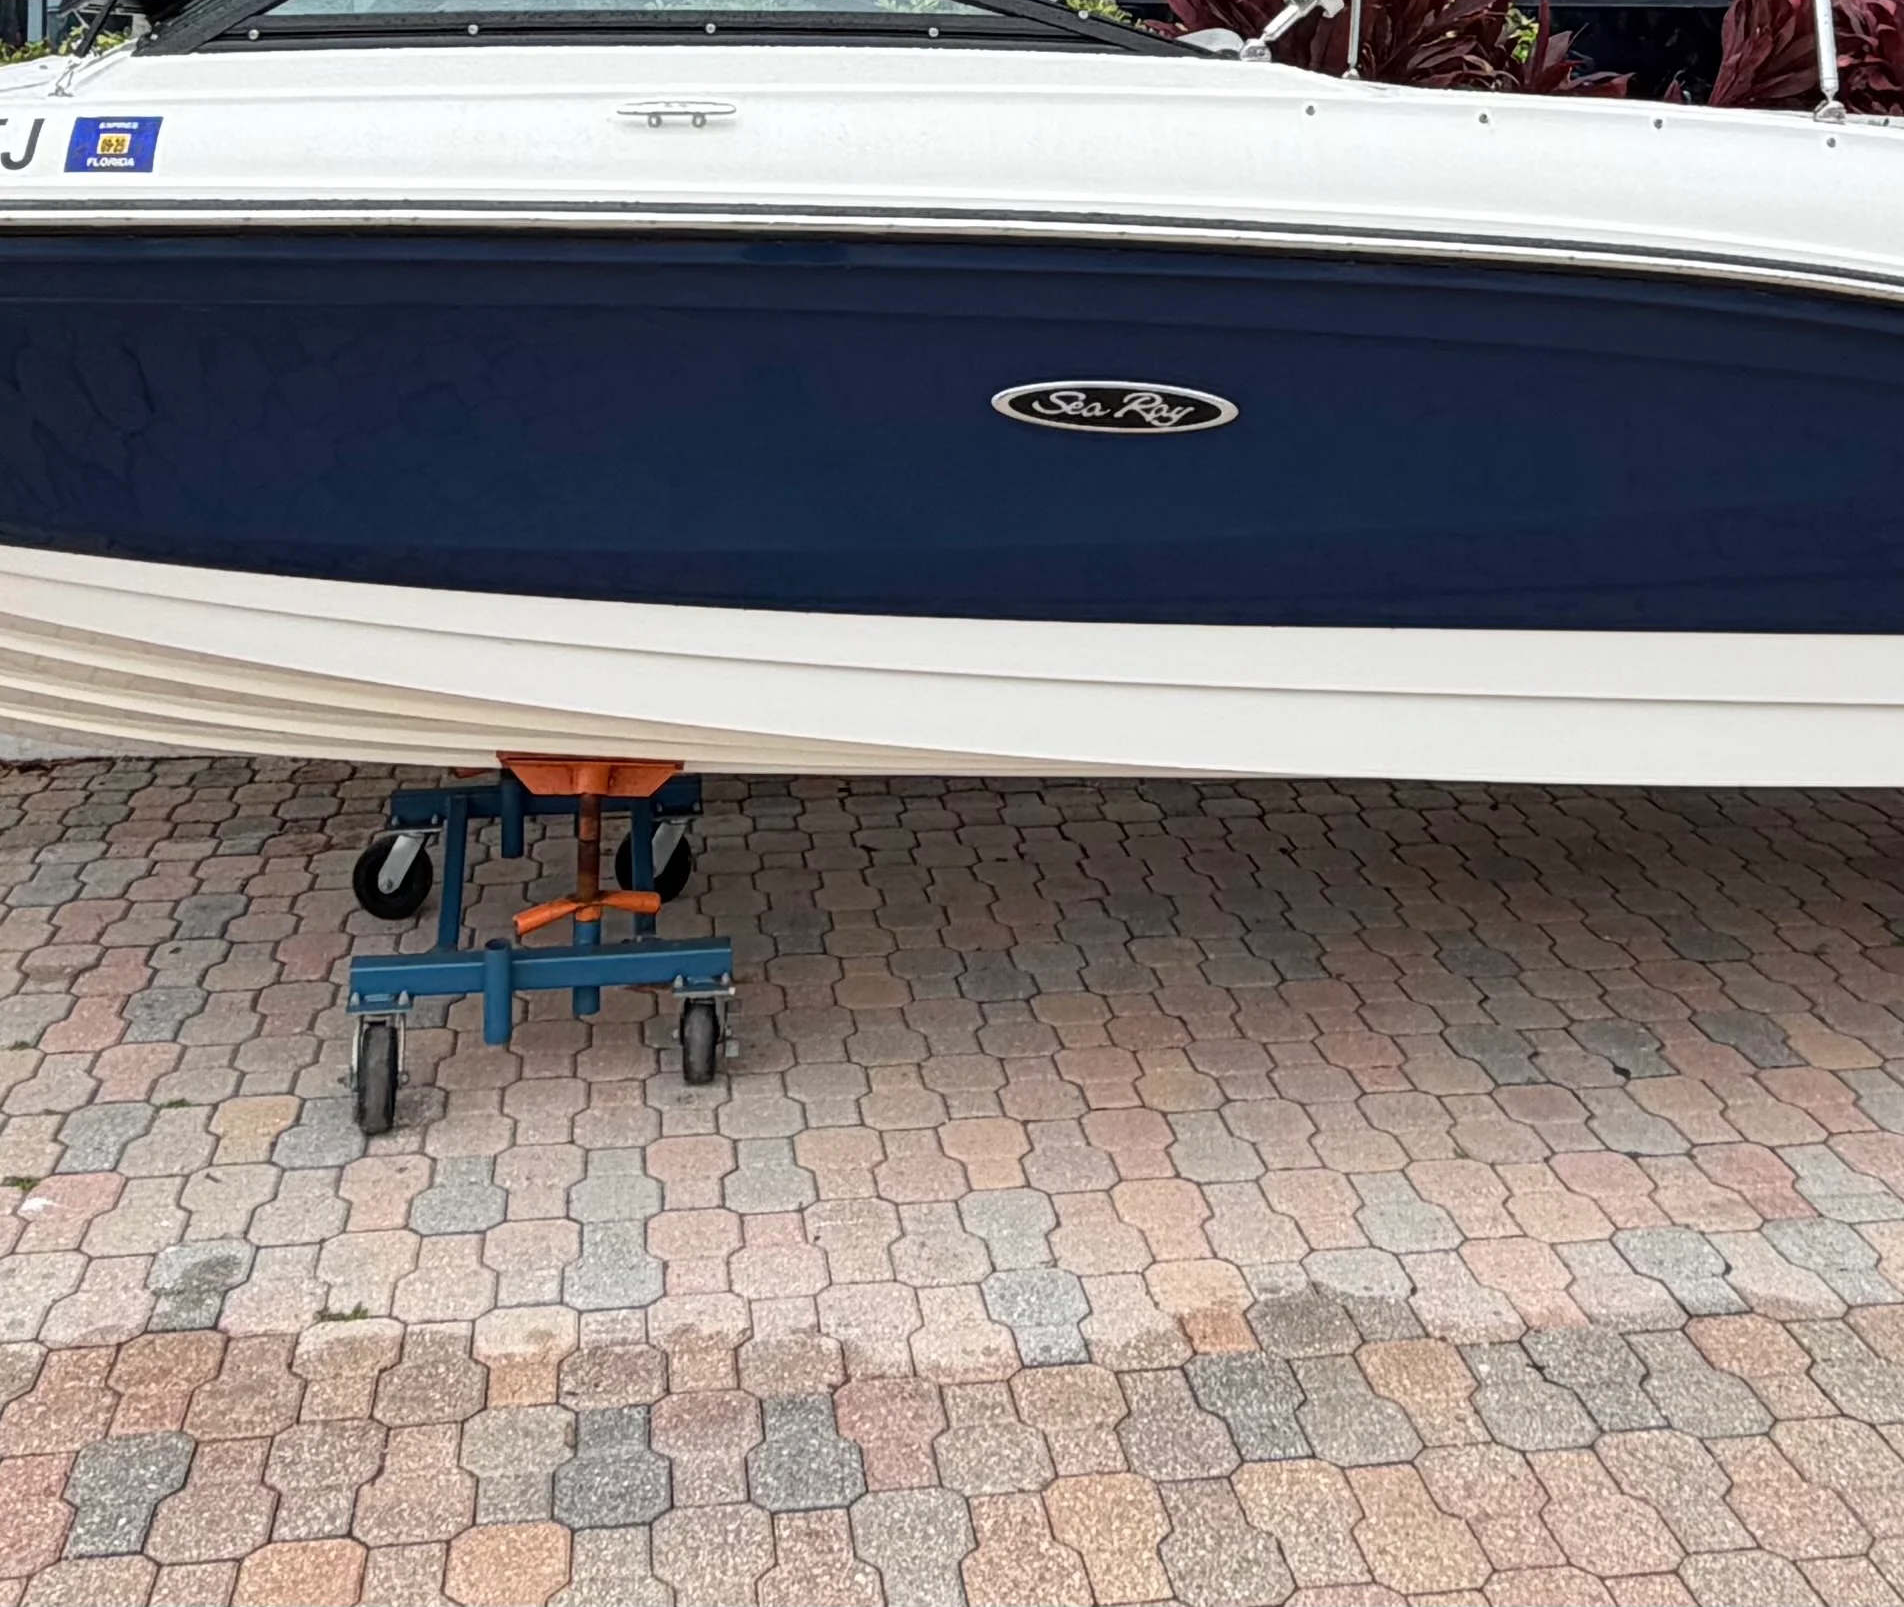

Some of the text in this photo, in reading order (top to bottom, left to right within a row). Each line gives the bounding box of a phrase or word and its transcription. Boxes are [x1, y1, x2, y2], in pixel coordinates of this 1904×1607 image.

[86, 157, 135, 167] FLORIDA
[1032, 390, 1195, 428] Sea Ray
